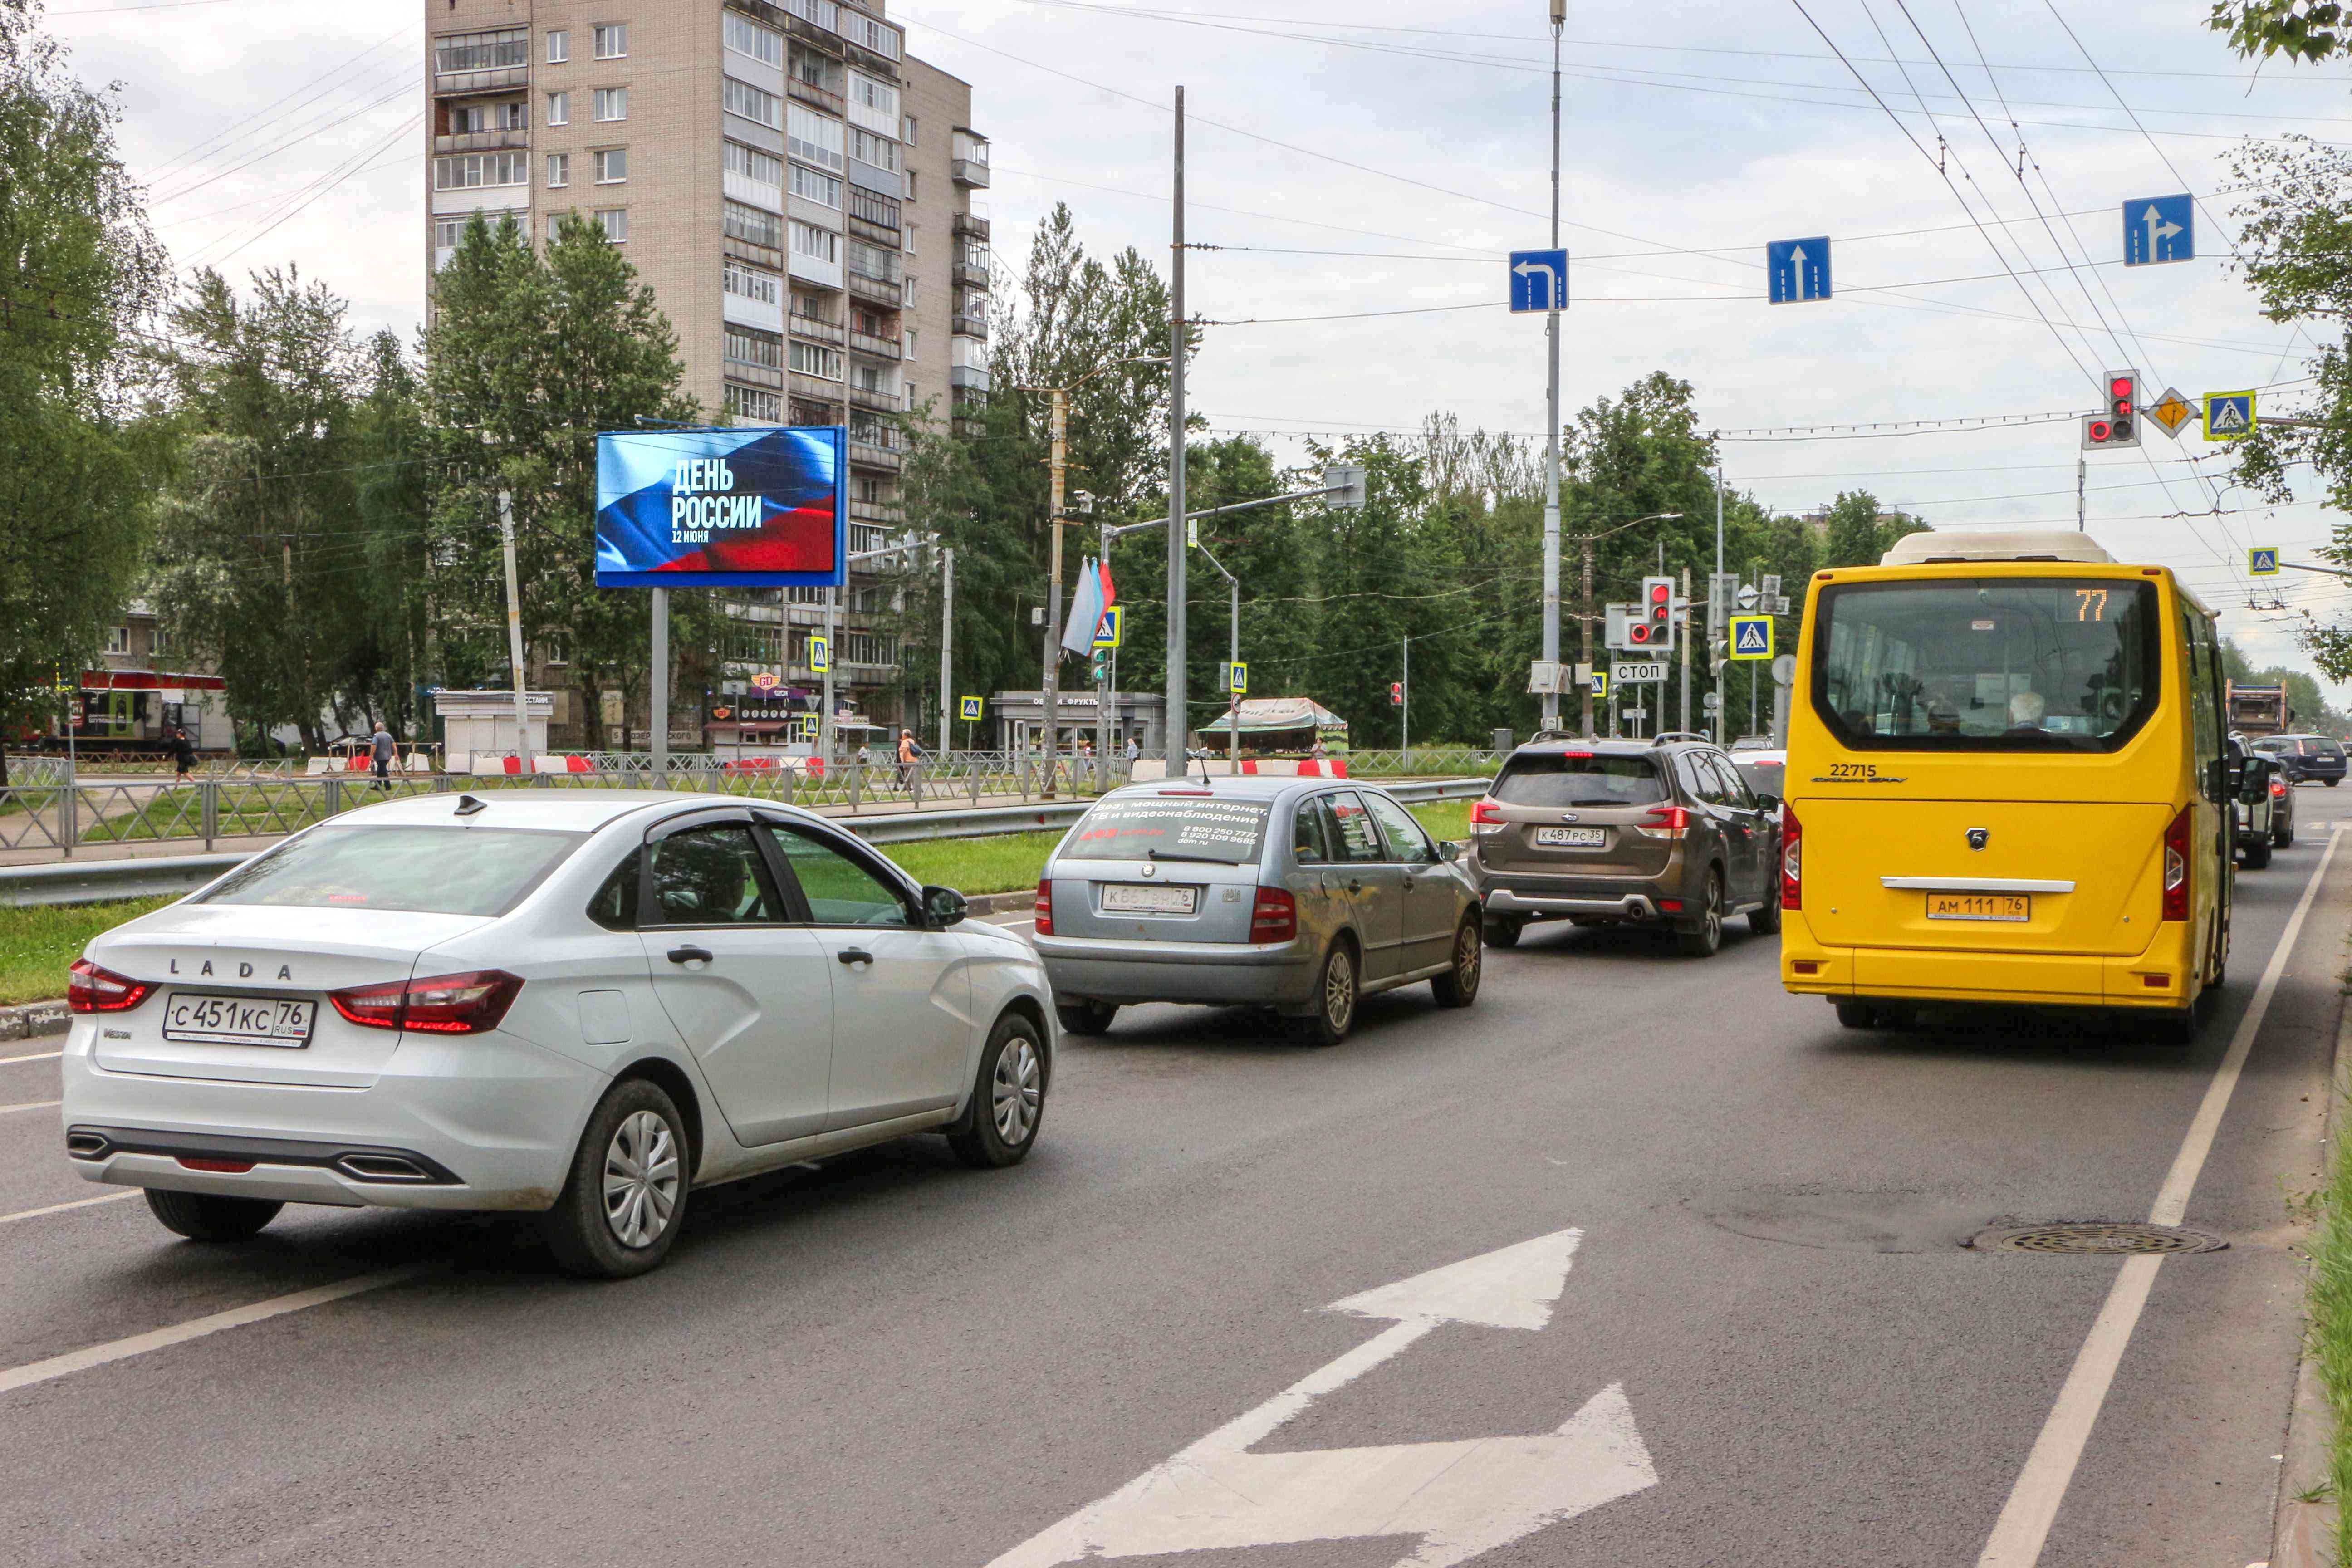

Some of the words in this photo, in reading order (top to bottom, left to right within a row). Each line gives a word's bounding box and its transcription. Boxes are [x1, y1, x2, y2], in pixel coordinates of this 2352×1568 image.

[672, 459, 734, 495] ДЕНЬ
[672, 495, 761, 529] РОССИИ
[672, 530, 682, 543] 12
[683, 530, 709, 543] ИЮНЯ
[2076, 589, 2108, 621] 77
[1619, 666, 1659, 679] СТОП
[1830, 764, 1876, 777] 22715
[1196, 802, 1268, 816] интернет,
[1091, 812, 1108, 821] ТВ
[1122, 810, 1259, 824] видеонаблюдение
[1230, 836, 1256, 845] 9685
[1235, 830, 1259, 839] 7777
[1589, 830, 1601, 839] 35
[1175, 889, 1188, 902] 76
[2006, 898, 2022, 910] 76
[170, 958, 292, 980] LADA
[279, 1003, 303, 1025] 76
[274, 1025, 293, 1034] RUS
